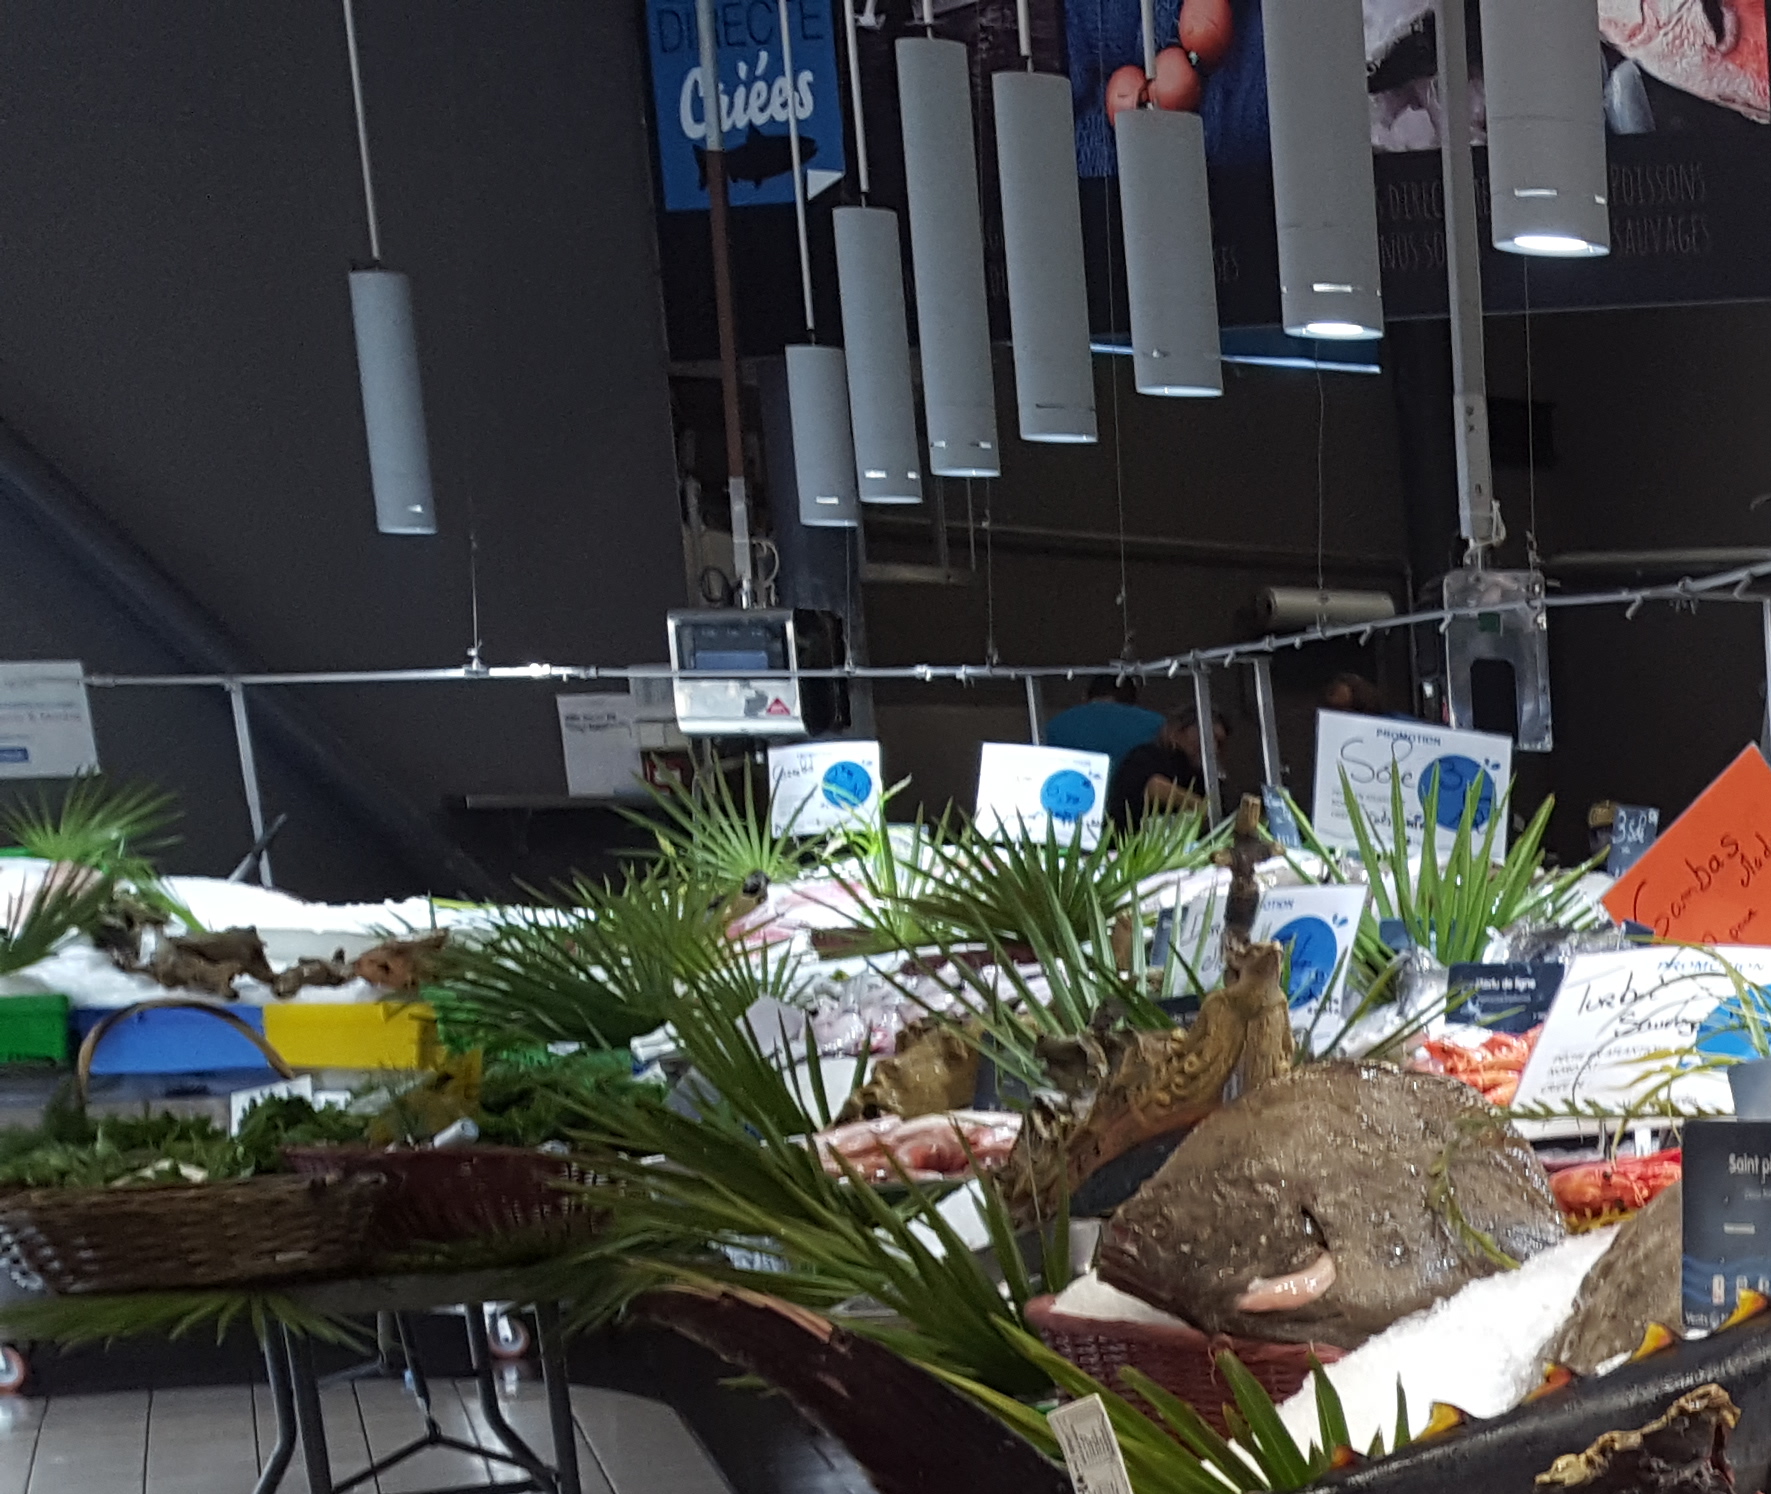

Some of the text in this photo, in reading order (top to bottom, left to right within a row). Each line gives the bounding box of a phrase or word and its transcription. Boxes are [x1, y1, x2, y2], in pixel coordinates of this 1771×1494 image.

[1375, 728, 1442, 747] PROMOTION
[1502, 976, 1514, 991] de
[1728, 1152, 1760, 1175] Saint
